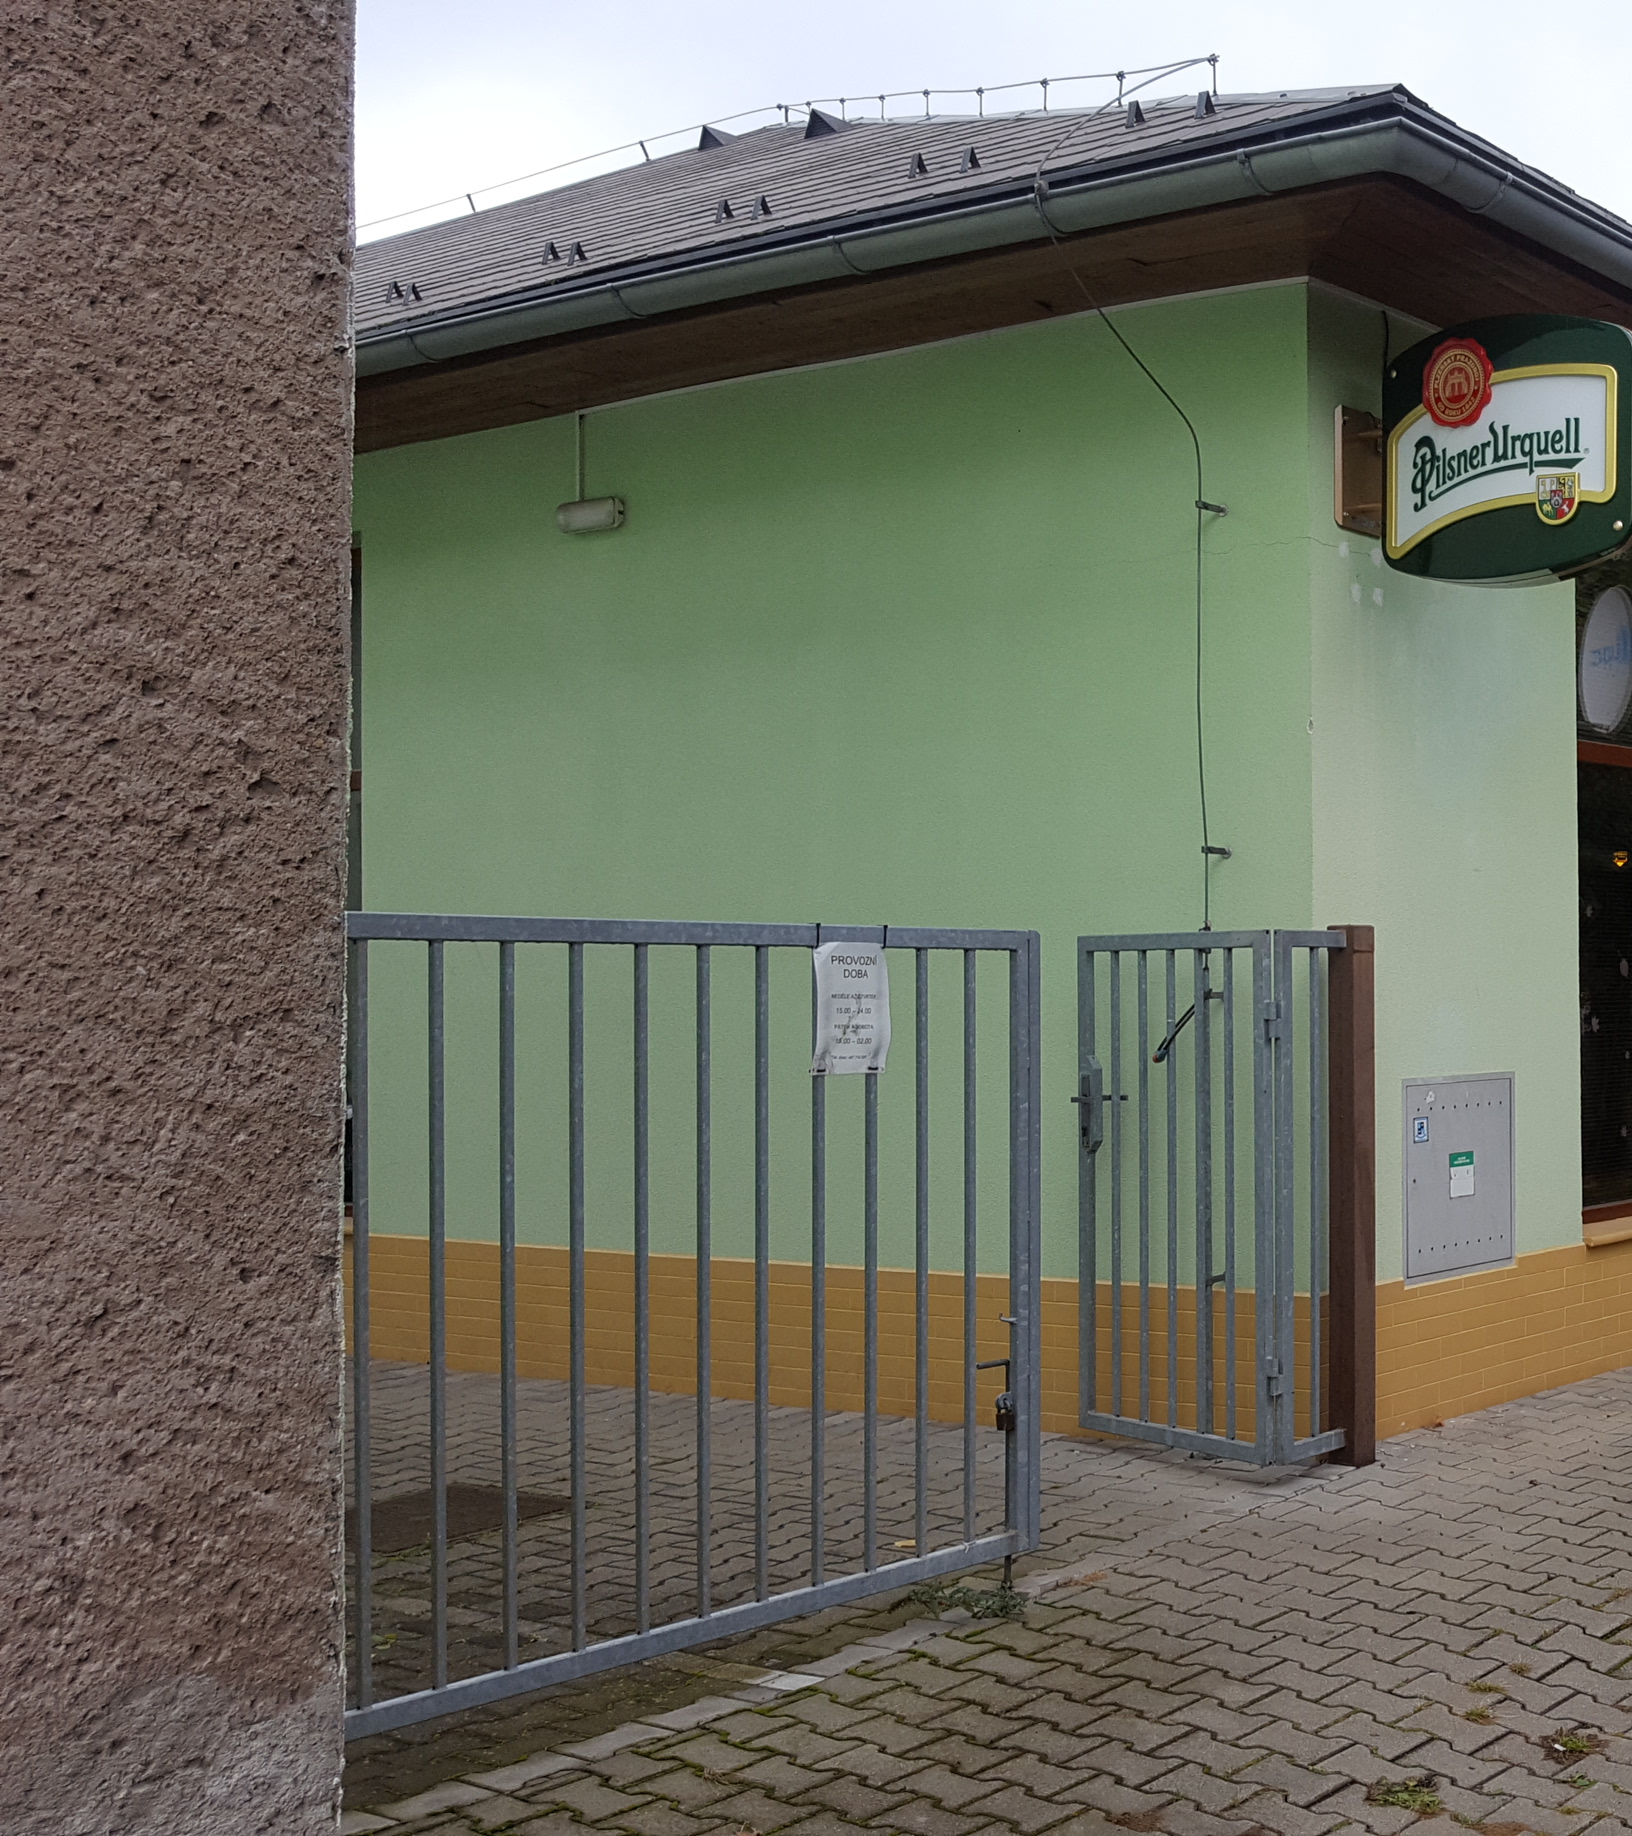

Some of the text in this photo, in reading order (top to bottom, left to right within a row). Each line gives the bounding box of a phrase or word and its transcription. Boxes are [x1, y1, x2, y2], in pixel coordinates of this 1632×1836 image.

[1411, 417, 1582, 513] Pilsner Urquell
[831, 954, 878, 966] PROVOZNÍ
[843, 968, 869, 979] DOBA
